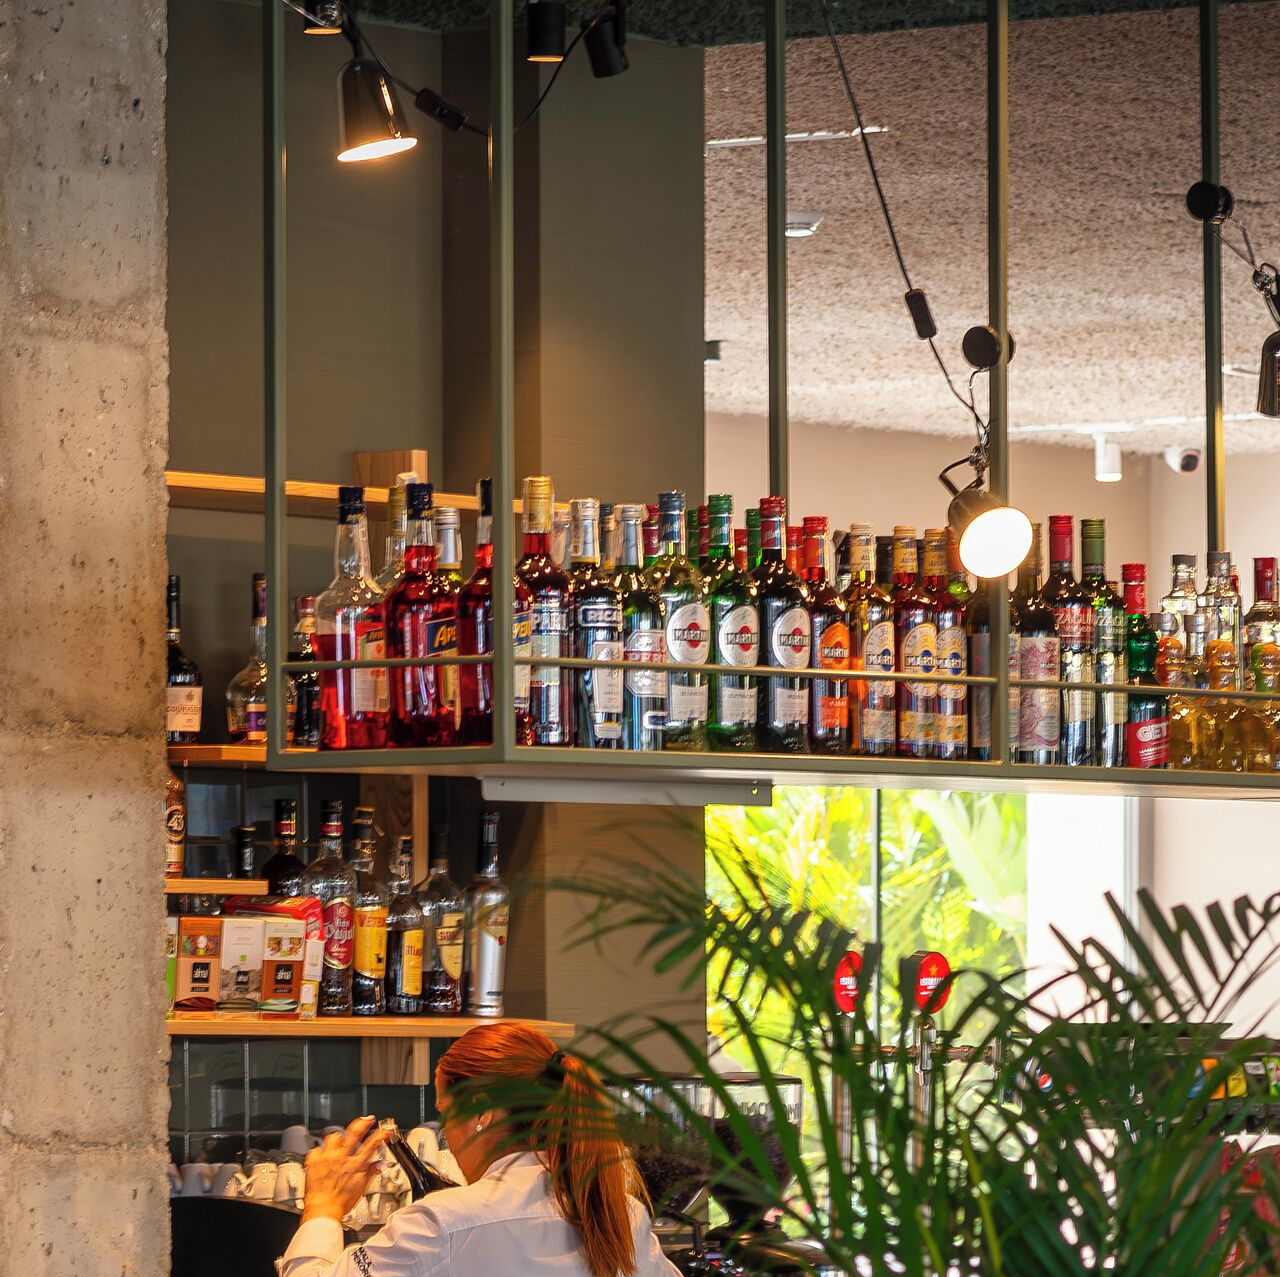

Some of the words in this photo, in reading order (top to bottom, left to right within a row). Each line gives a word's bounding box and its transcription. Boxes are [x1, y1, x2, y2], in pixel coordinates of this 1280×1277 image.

[531, 612, 568, 630] PARI
[587, 610, 618, 621] RICA
[433, 624, 458, 648] APE
[674, 629, 708, 641] MARTI
[727, 633, 758, 644] MARTI
[779, 634, 809, 646] MARTI
[822, 646, 849, 658] MARTI
[868, 655, 895, 666] MART
[907, 655, 936, 667] MART
[936, 658, 964, 670] MART
[1136, 721, 1169, 742] GET
[167, 812, 184, 830] 43
[357, 914, 387, 928] VETER
[356, 1246, 372, 1269] MALA
